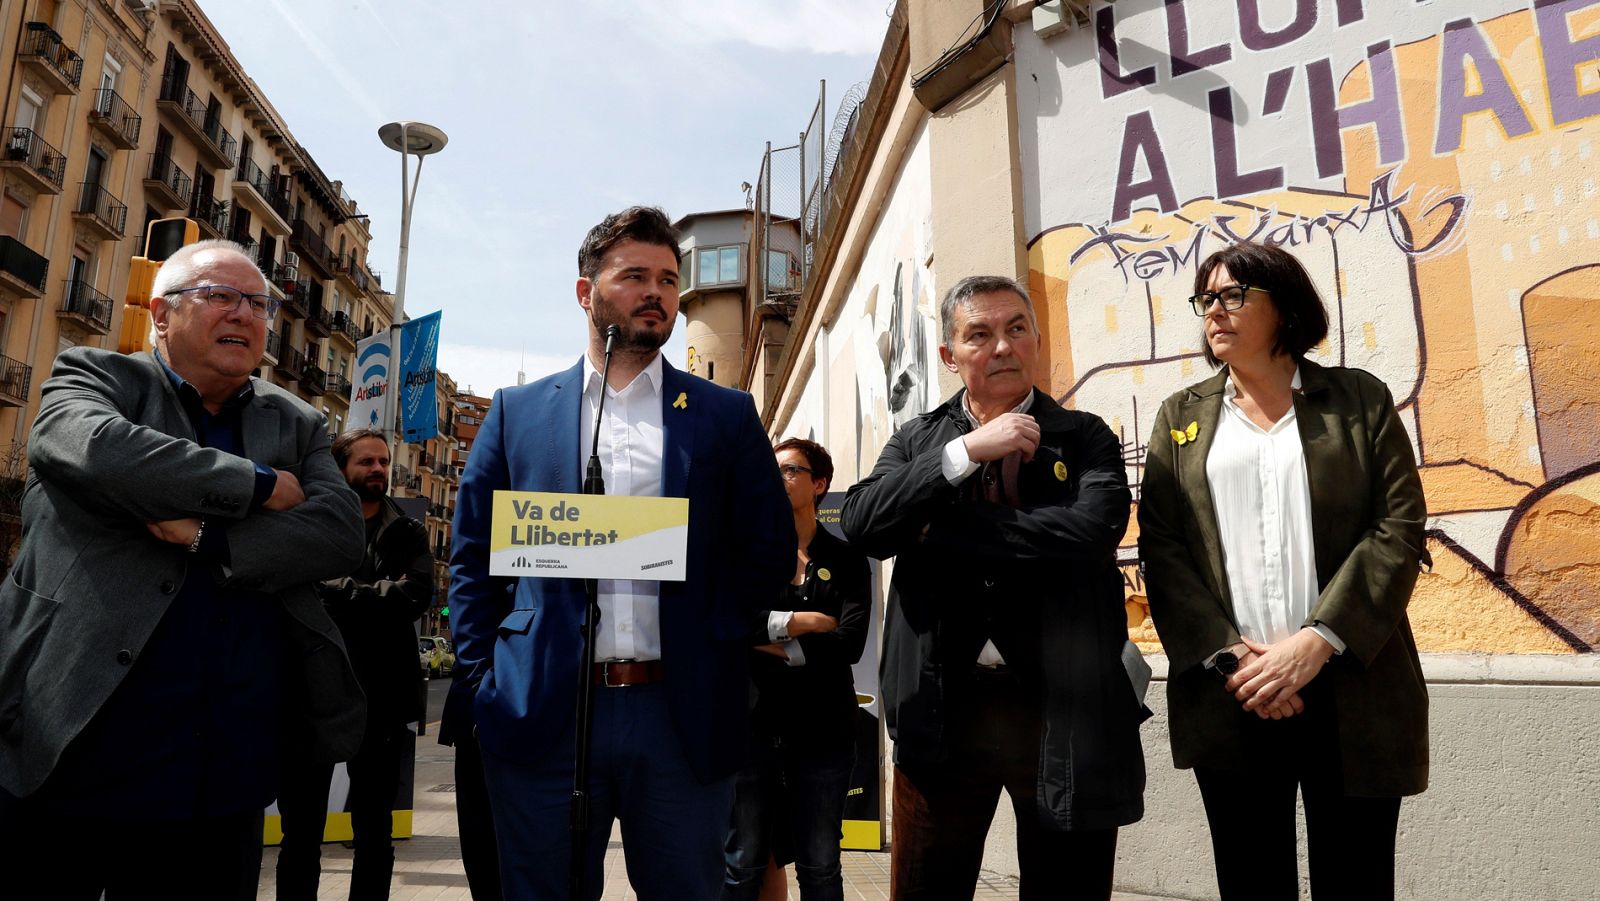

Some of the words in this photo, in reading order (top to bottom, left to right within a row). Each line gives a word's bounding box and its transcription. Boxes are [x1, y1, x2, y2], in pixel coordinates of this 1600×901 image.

[1111, 111, 1180, 222] A
[511, 500, 543, 520] Va
[550, 501, 580, 521] de
[510, 525, 618, 546] Llibertat
